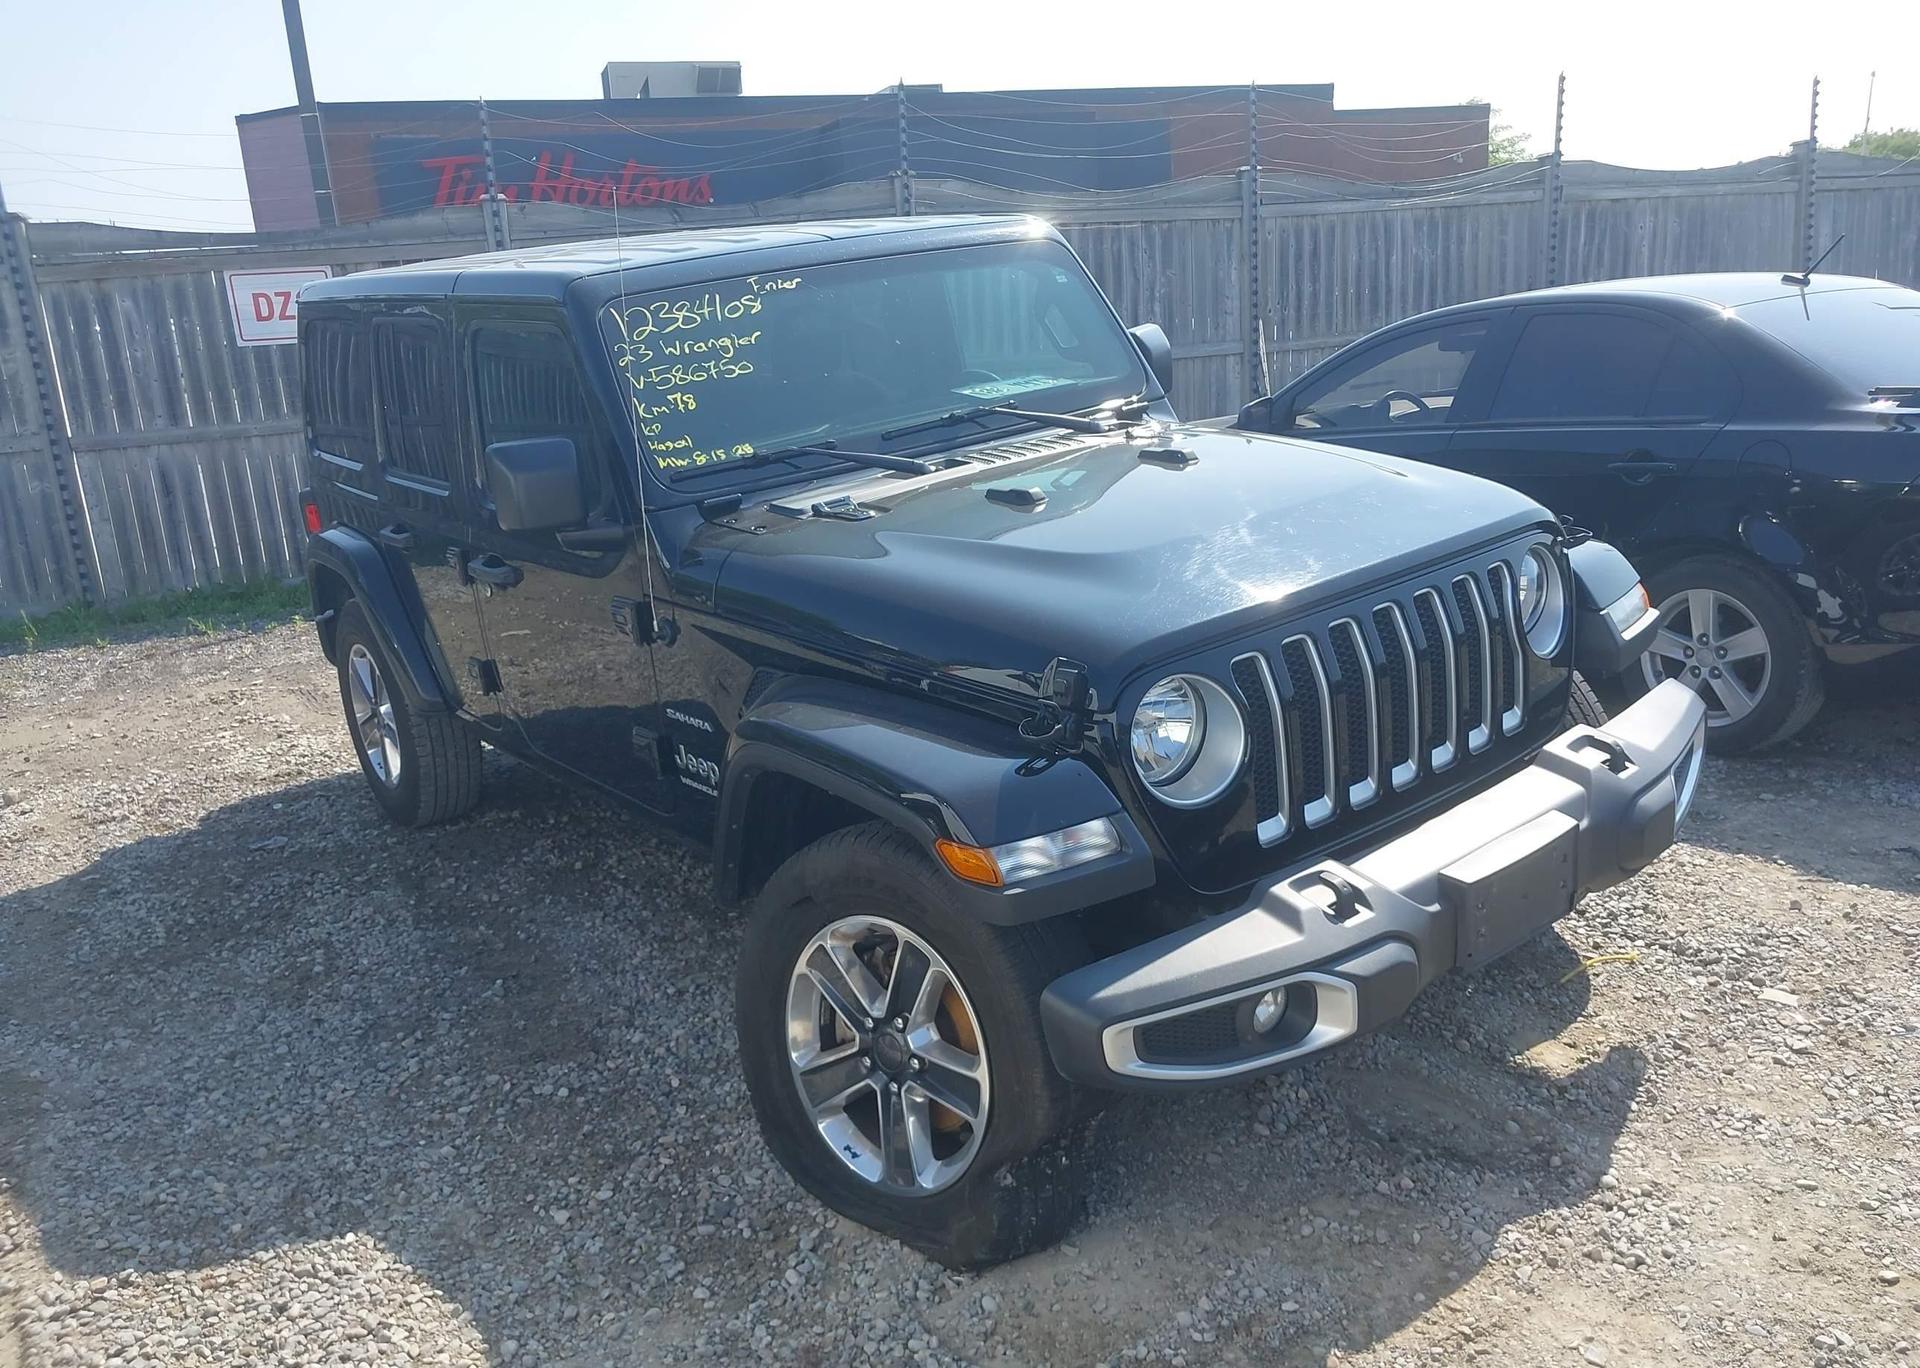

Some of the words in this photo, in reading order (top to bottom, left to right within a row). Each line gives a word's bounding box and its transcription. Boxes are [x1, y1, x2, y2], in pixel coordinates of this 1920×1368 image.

[530, 150, 713, 207] Hortons
[251, 290, 300, 322] DZ
[609, 293, 762, 341] 12384108
[614, 344, 653, 366] 23
[665, 708, 713, 732] SAHARA
[674, 744, 720, 787] Jeep
